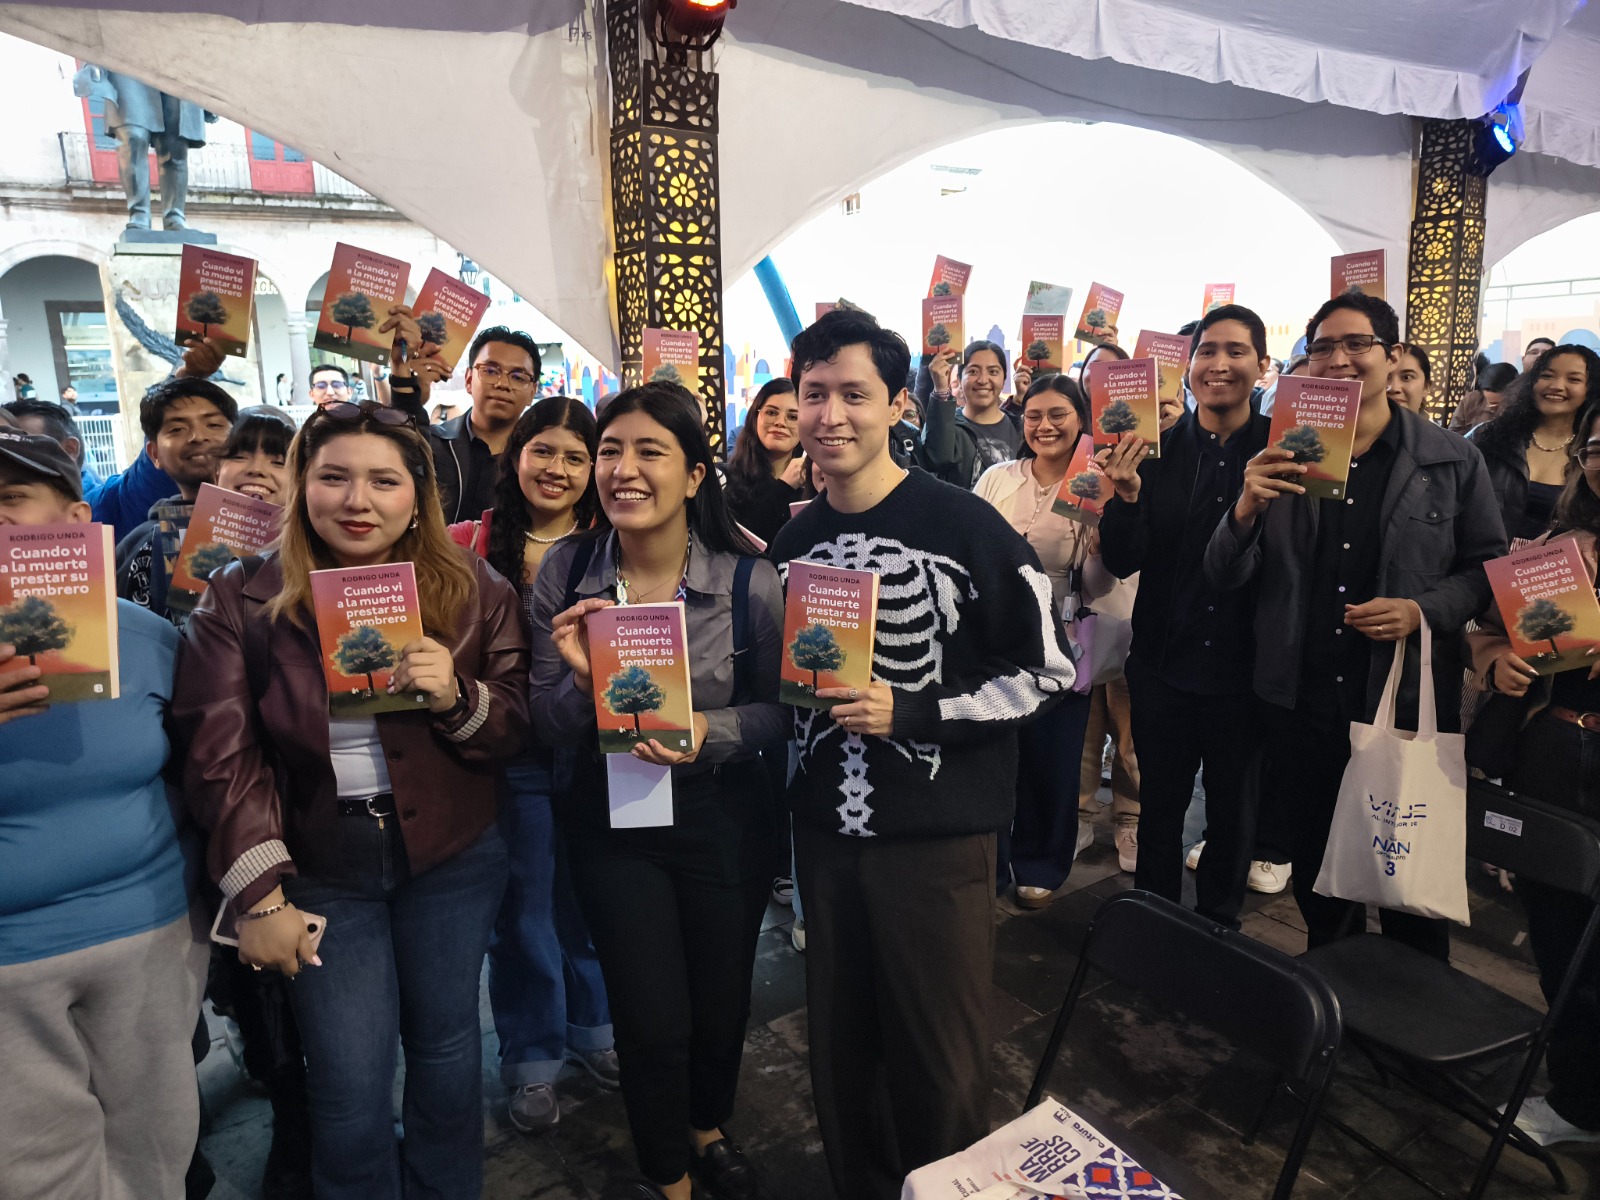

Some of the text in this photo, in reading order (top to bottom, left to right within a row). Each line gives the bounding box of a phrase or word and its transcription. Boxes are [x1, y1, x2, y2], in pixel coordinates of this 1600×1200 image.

[202, 261, 234, 274] Cuando
[355, 261, 399, 280] Cuando vi
[200, 277, 230, 289] prestar
[211, 272, 243, 283] muerte
[354, 269, 362, 277] la
[363, 273, 396, 287] muerte
[201, 284, 242, 297] sombrero
[351, 278, 395, 294] prestar su
[351, 286, 393, 301] sombrero
[442, 286, 477, 309] Cuando vi
[434, 299, 470, 321] prestar su
[439, 292, 445, 301] la
[446, 298, 473, 315] muerte
[433, 306, 467, 327] sombrero
[1109, 372, 1138, 380] Cuando
[1109, 388, 1136, 396] prestar
[1300, 392, 1337, 403] Cuando
[1310, 403, 1346, 412] muerte
[1296, 411, 1331, 419] prestar
[1296, 419, 1344, 429] sombrero
[220, 507, 269, 528] Cuando vi
[217, 516, 226, 525] la
[228, 521, 267, 536] muerte
[212, 526, 264, 545] prestar su
[11, 545, 86, 559] Cuando vi
[1512, 548, 1564, 566] RODRIGO UNDA
[0, 560, 87, 573] a la muerte
[1515, 557, 1568, 577] Cuando vi
[11, 573, 88, 588] prestar su
[342, 574, 376, 582] RODRIGO
[809, 573, 838, 582] RODRIGO
[1531, 567, 1571, 583] muerte
[14, 585, 89, 598] sombrero
[344, 582, 402, 596] Cuando vi
[808, 584, 860, 598] Cuando vi
[1520, 579, 1559, 595] prestar
[1525, 584, 1577, 602] sombrero
[346, 598, 357, 607] la
[360, 595, 404, 606] muerte
[809, 595, 817, 604] la
[820, 598, 859, 609] muerte
[346, 605, 405, 619] prestar su
[807, 607, 843, 617] prestar
[350, 615, 407, 628] sombrero
[808, 617, 858, 629] sombrero
[617, 625, 671, 636] Cuando vi
[619, 638, 628, 646] la
[631, 637, 672, 645] muerte
[618, 648, 658, 659] prestar
[621, 657, 674, 667] sombrero
[1373, 836, 1410, 854] NAN
[1385, 861, 1395, 876] 3
[1045, 1135, 1081, 1163] COS
[1019, 1156, 1051, 1183] MA
